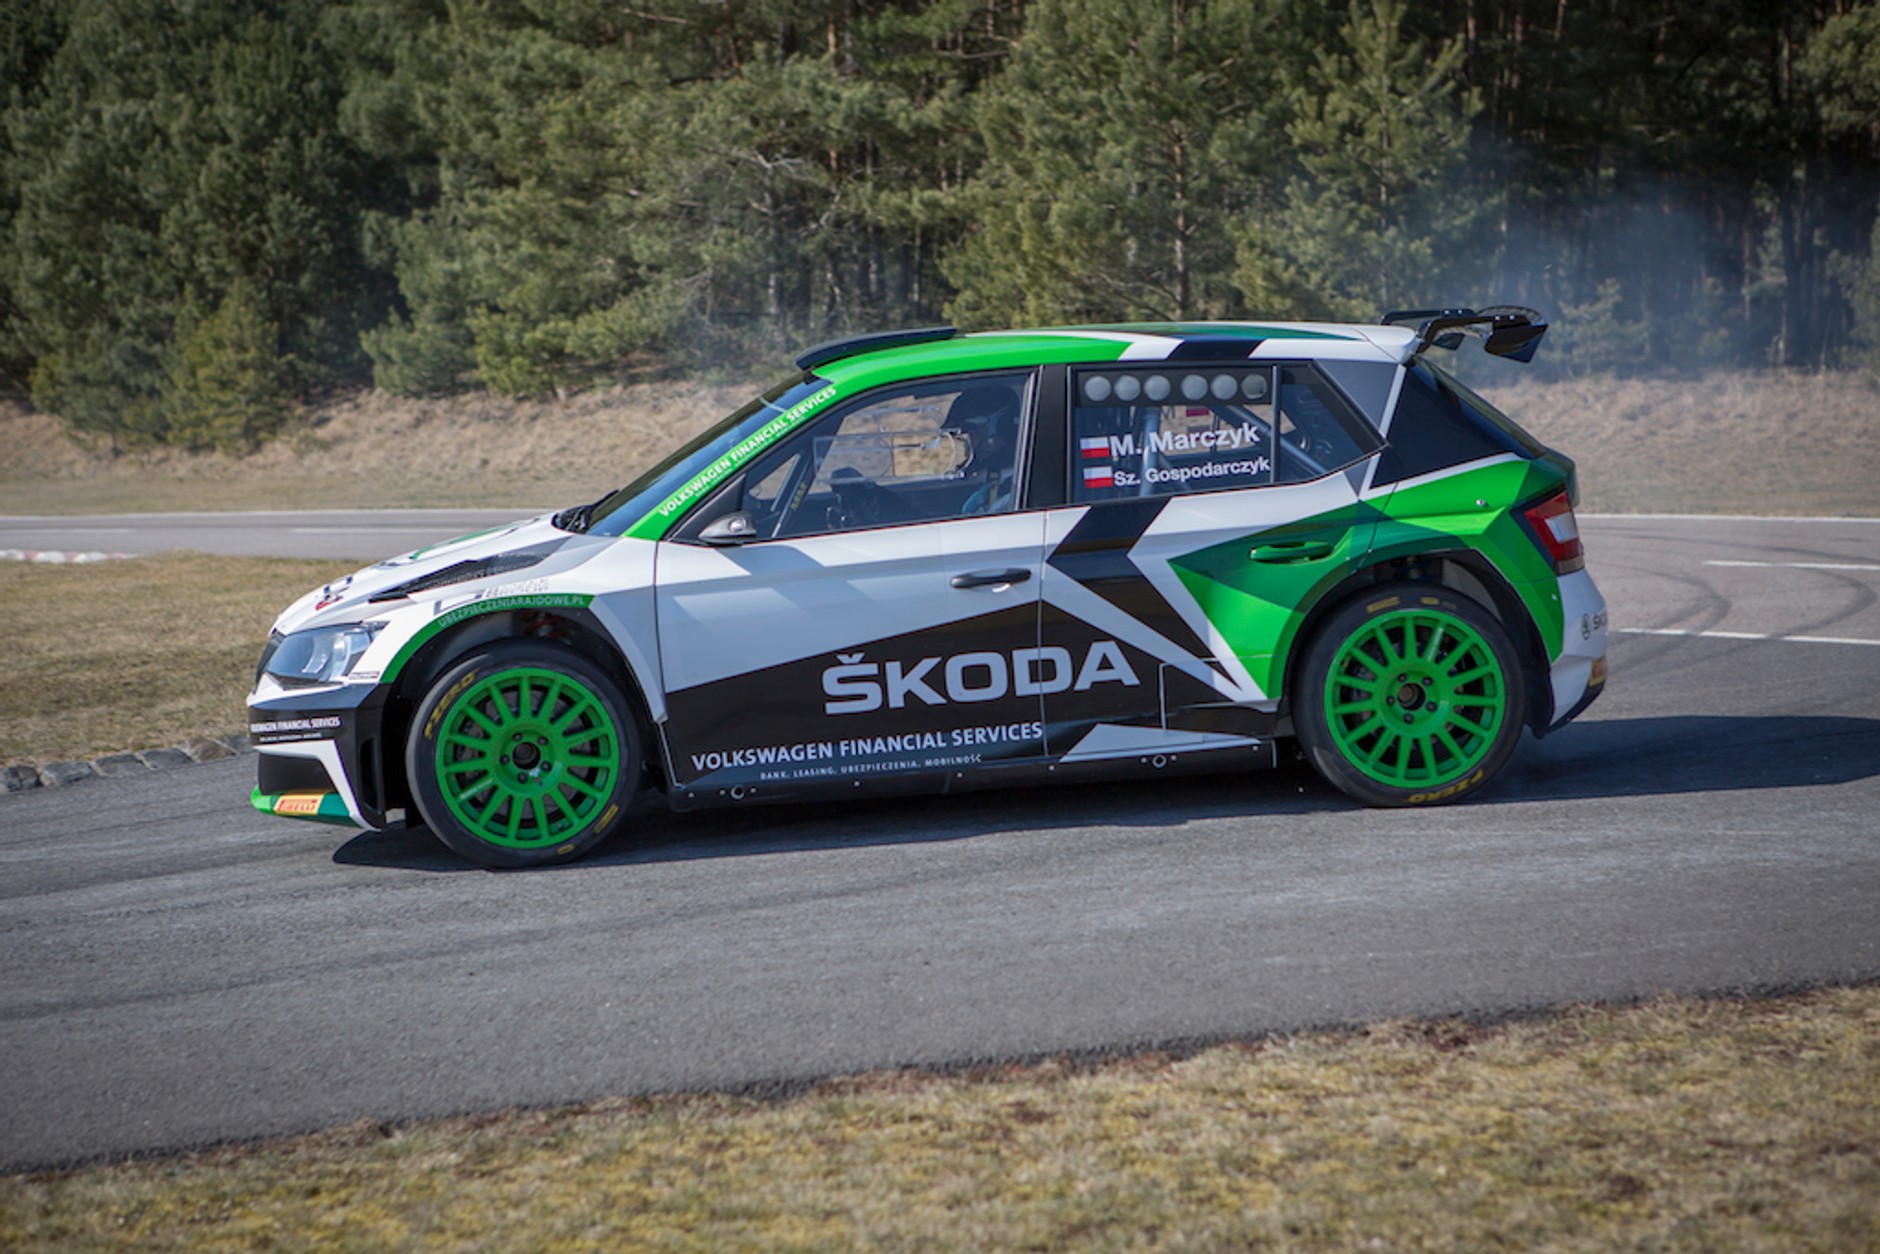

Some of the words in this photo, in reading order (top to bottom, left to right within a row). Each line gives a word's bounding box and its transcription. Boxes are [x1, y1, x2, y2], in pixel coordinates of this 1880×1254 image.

[658, 458, 731, 516] VOLKSWAGEN
[730, 419, 788, 461] FINANCIAL
[785, 386, 837, 421] SERVICES
[1109, 433, 1143, 457] M.
[1149, 422, 1261, 454] Marczyk
[1113, 470, 1142, 487] Sz.
[1145, 456, 1271, 484] Gospodarczyk
[821, 641, 1141, 715] ŠKODA
[690, 742, 833, 771] VOLKSWAGEN
[840, 731, 947, 757] FINANCIAL
[951, 722, 1043, 747] SERVICES
